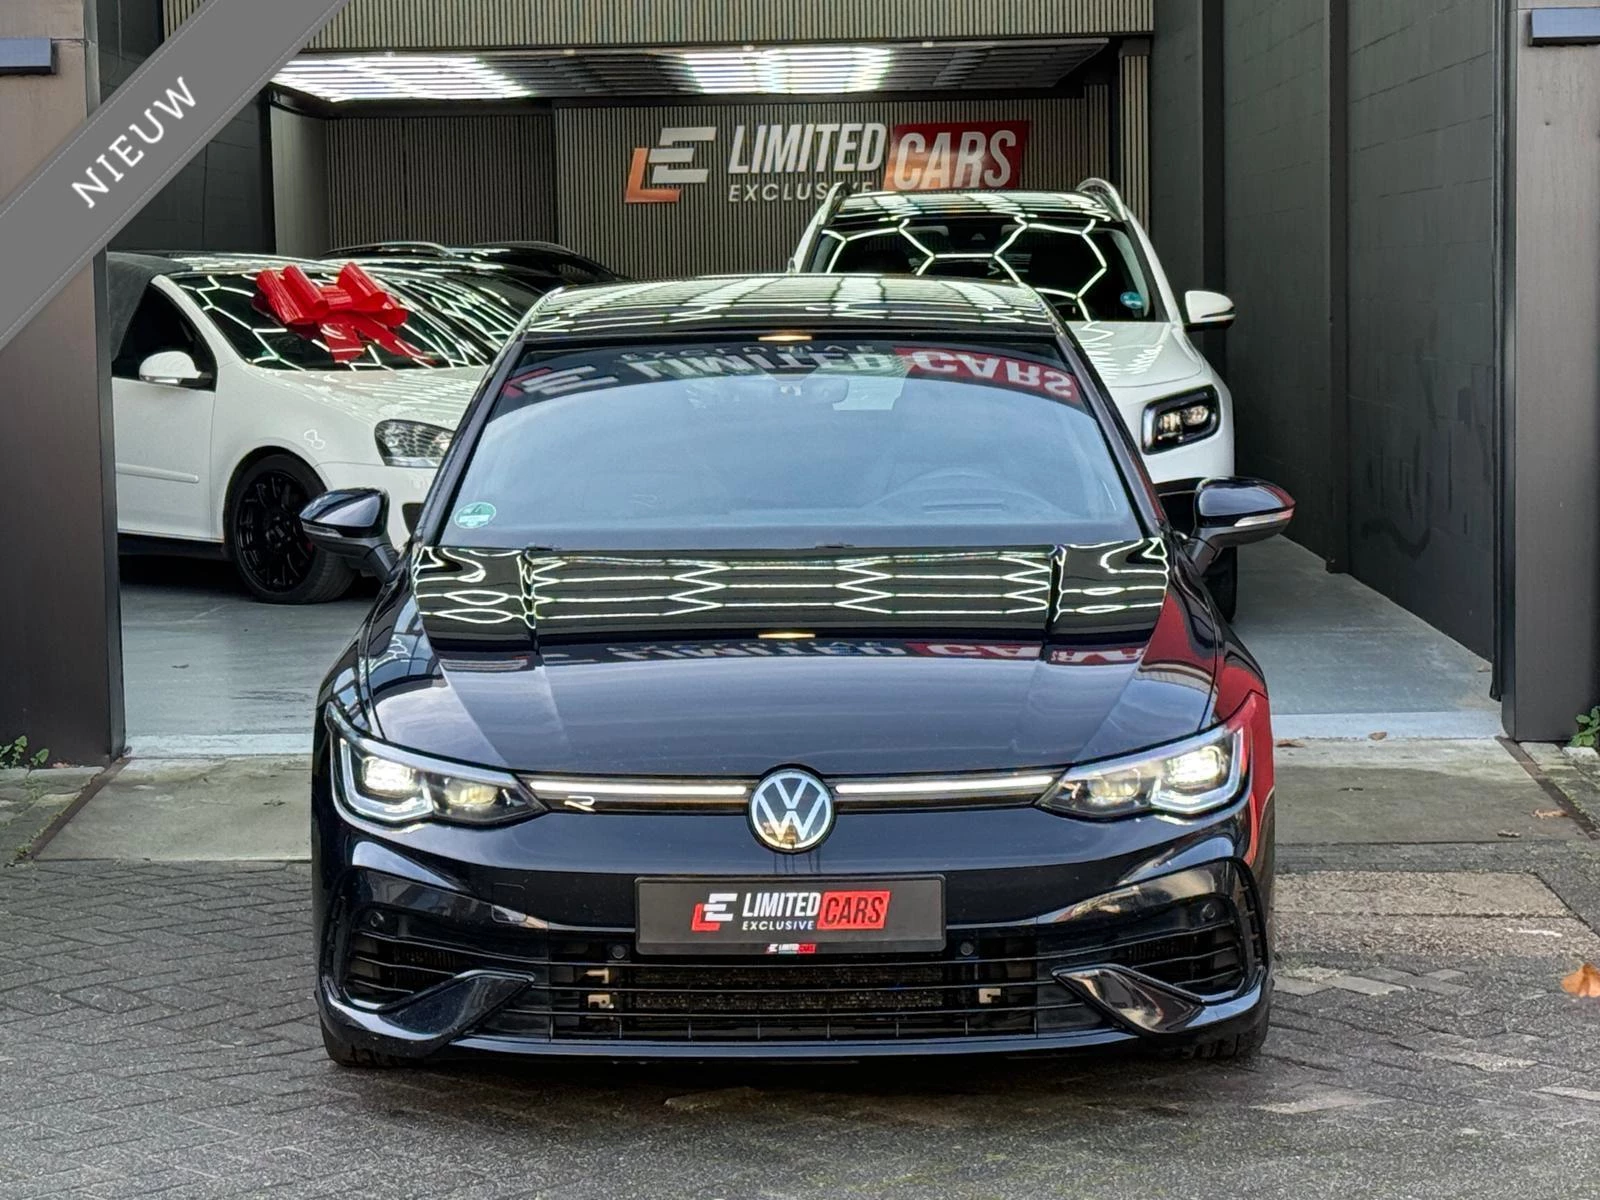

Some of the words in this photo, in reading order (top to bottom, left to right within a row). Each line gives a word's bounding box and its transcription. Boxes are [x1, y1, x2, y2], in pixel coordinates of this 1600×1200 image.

[727, 122, 887, 174] LIMITED
[893, 130, 1018, 191] CARS
[728, 182, 873, 202] EXCLUSE
[564, 795, 596, 812] R
[742, 892, 822, 917] LIMITED
[824, 897, 884, 924] CARS
[742, 920, 814, 931] EXCLUSIVE
